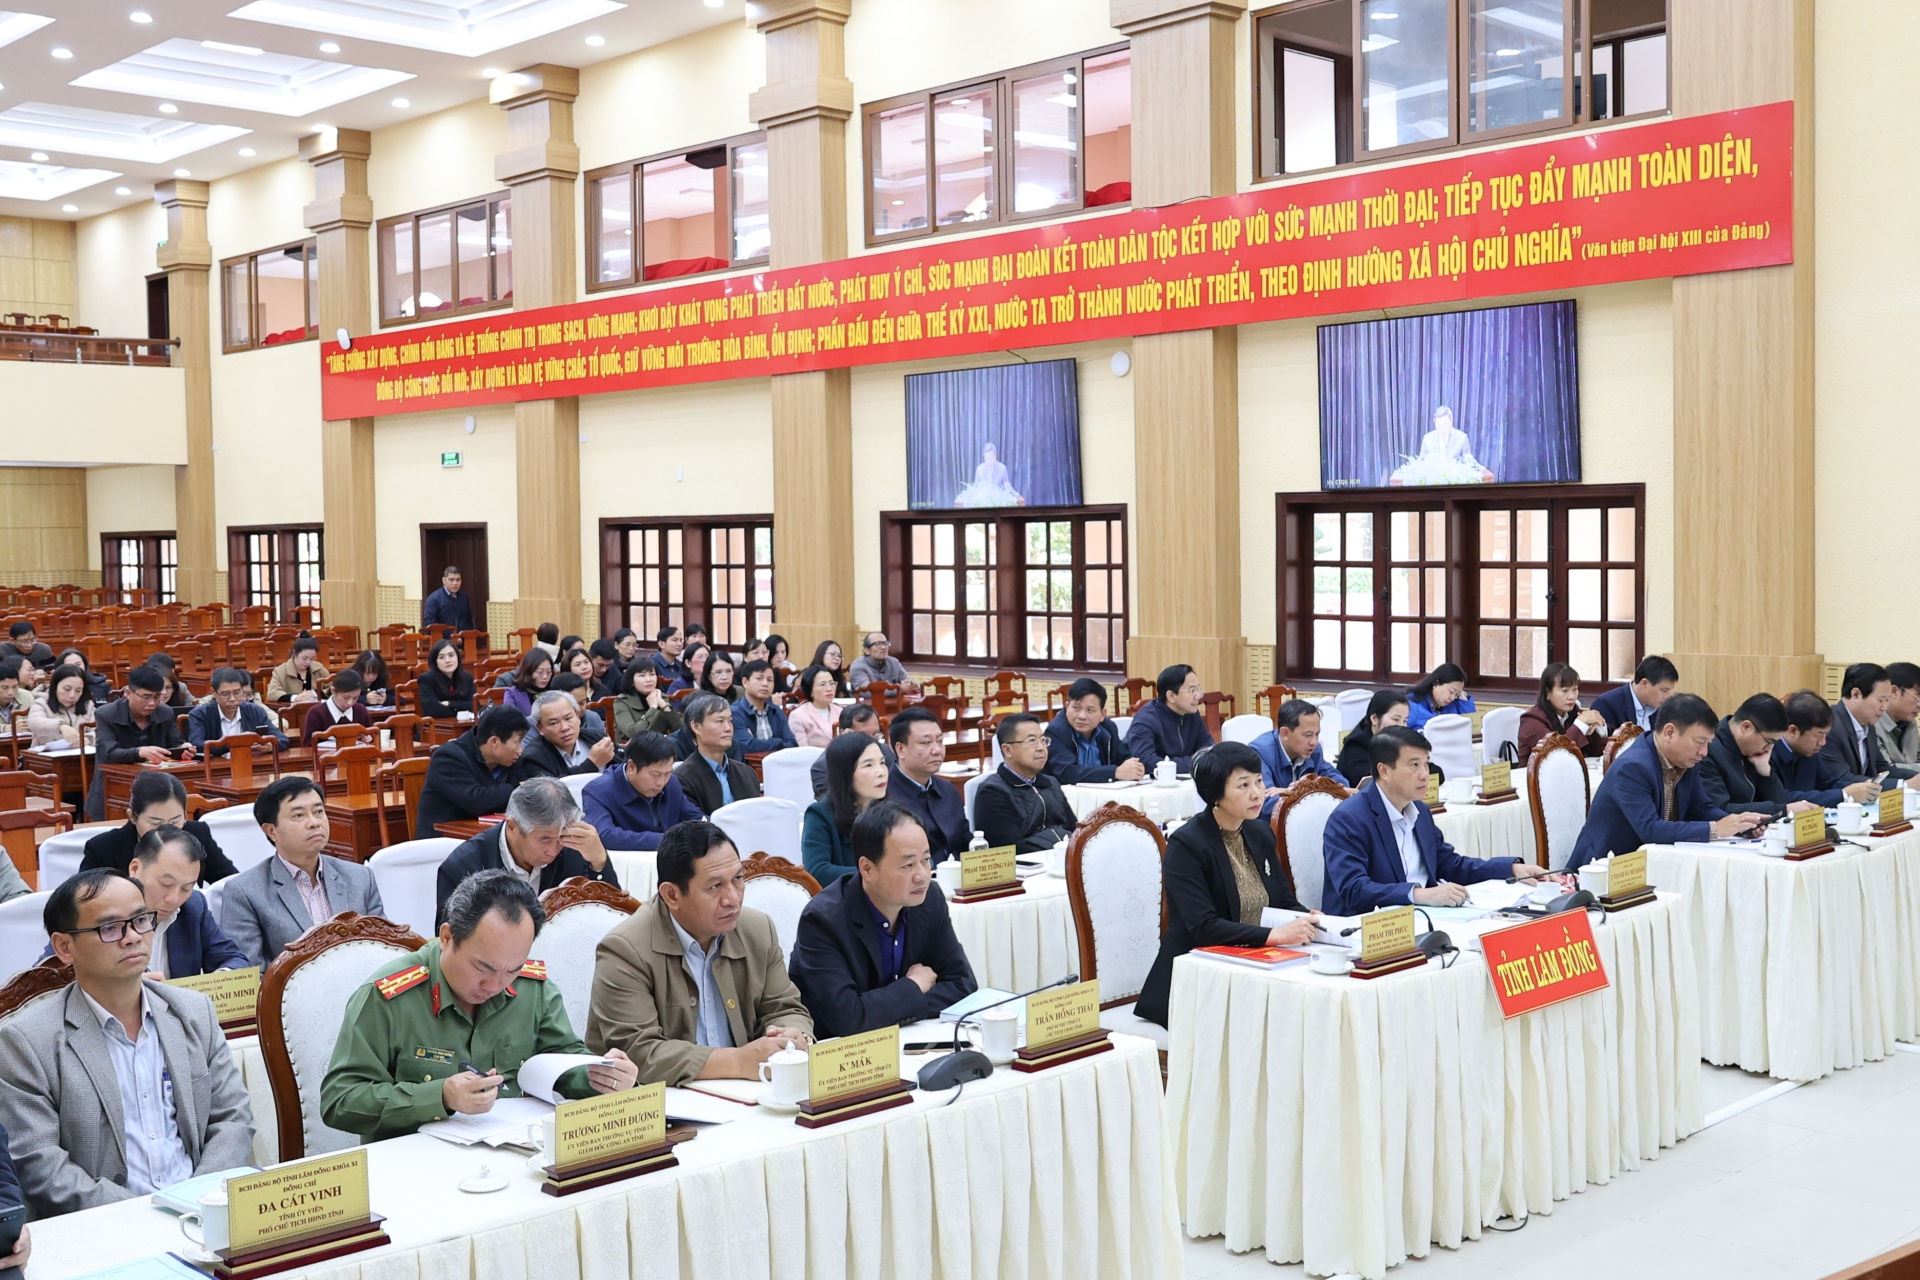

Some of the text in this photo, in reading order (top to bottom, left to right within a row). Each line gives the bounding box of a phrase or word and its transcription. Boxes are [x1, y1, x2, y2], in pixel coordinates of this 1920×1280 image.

[366, 347, 380, 369] XÂY
[476, 328, 500, 354] THỐNG
[500, 328, 524, 351] CHÍNH
[523, 327, 537, 349] TRỊ
[537, 323, 563, 345] TRONG
[563, 320, 587, 344] SẠCH,
[587, 314, 611, 338] VỮNG
[610, 312, 639, 337] MẠNH;
[638, 307, 660, 332] KHƠI
[660, 303, 679, 331] DẬY
[678, 302, 703, 326] KHÁT
[703, 298, 729, 326] VỌNG
[729, 294, 754, 318] PHÁT
[757, 281, 786, 315] TRIỂN
[786, 279, 807, 312] ĐẤT
[808, 278, 838, 308] NƯỚC,
[840, 277, 868, 304] PHÁT
[869, 273, 890, 300] HUY
[894, 268, 901, 296] Ý
[904, 268, 927, 295] CHÍ,
[928, 260, 952, 291] SỨC
[954, 258, 989, 291] MẠNH
[992, 255, 1014, 285] ĐẠI
[1016, 249, 1051, 279] ĐOÀN
[1053, 238, 1078, 274] KẾT
[1081, 235, 1116, 269] TOÀN
[1119, 230, 1148, 264] DÂN
[1152, 224, 1178, 264] TỘC
[1181, 216, 1208, 255] KẾT
[1212, 216, 1241, 255] HỢP
[1245, 209, 1270, 246] VỚI
[1274, 205, 1305, 242] SỨC
[1309, 200, 1358, 240] MẠNH
[1363, 189, 1400, 228] THỜI
[1404, 188, 1439, 227] ĐẠI;
[1444, 173, 1484, 217] TIẾP
[1489, 174, 1524, 216] TỤC
[1529, 156, 1566, 205] ĐẨY
[1572, 157, 1632, 202] MẠNH
[1638, 143, 1692, 188] TOÀN
[1698, 133, 1759, 184] DIỆN,
[394, 379, 404, 399] BỘ
[470, 367, 485, 390] XÂY
[485, 366, 506, 388] DỰNG
[533, 358, 545, 385] VỆ
[544, 357, 566, 381] VỮNG
[566, 351, 588, 379] CHẮC
[588, 348, 600, 376] TỔ
[600, 347, 624, 377] QUỐC,
[624, 347, 641, 373] GIỮ
[641, 345, 666, 370] VỮNG
[666, 341, 686, 368] MÔI
[686, 337, 722, 366] TRƯỜNG
[722, 337, 743, 362] HÒA
[743, 334, 771, 359] BÌNH,
[771, 324, 787, 356] ỔN
[787, 328, 817, 357] ĐỊNH;
[817, 318, 847, 350] PHẤN
[847, 315, 871, 347] ĐẤU
[870, 312, 896, 344] ĐẾN
[896, 310, 923, 341] GIỮA
[925, 304, 949, 338] THẾ
[949, 302, 965, 335] KỶ
[968, 306, 992, 333] XXI,
[994, 295, 1028, 330] NƯỚC
[1030, 298, 1048, 325] TA
[1050, 286, 1075, 323] TRỞ
[1078, 285, 1123, 320] THÀNH
[1126, 278, 1163, 313] NƯỚC
[1166, 274, 1202, 309] PHÁT
[1206, 261, 1255, 304] TRIỂN,
[1259, 264, 1299, 298] THEO
[1302, 259, 1342, 296] ĐỊNH
[1346, 246, 1403, 287] HƯỚNG
[1408, 241, 1432, 279] XÃ
[1438, 235, 1467, 280] HỘI
[1472, 227, 1509, 272] CHỦ
[1582, 243, 1608, 259] (Văn
[1610, 239, 1636, 256] kiện
[1638, 236, 1658, 251] Đại
[1660, 233, 1679, 251] hội
[1681, 230, 1702, 246] XIII
[1705, 226, 1729, 243] của
[1731, 222, 1770, 240] Đảng)
[1497, 926, 1598, 997] TỈNH LÂM ĐỒNG
[233, 988, 255, 998] MINH
[1077, 1002, 1093, 1015] THÁI
[851, 1056, 872, 1069] MÁK
[562, 1124, 600, 1140] TRƯƠNG
[602, 1118, 626, 1132] MINH
[239, 1185, 253, 1193] BCH
[272, 1177, 281, 1185] BỘ
[299, 1170, 313, 1178] LÂM
[314, 1165, 331, 1175] ĐỒNG
[333, 1163, 350, 1171] KHÓA
[283, 1183, 303, 1192] ĐỒNG
[258, 1186, 342, 1215] ĐA CÁT VINH
[308, 1205, 324, 1214] VIÊN
[258, 1225, 273, 1235] PHÓ
[274, 1222, 289, 1231] CHỦ
[290, 1219, 306, 1228] TỊCH
